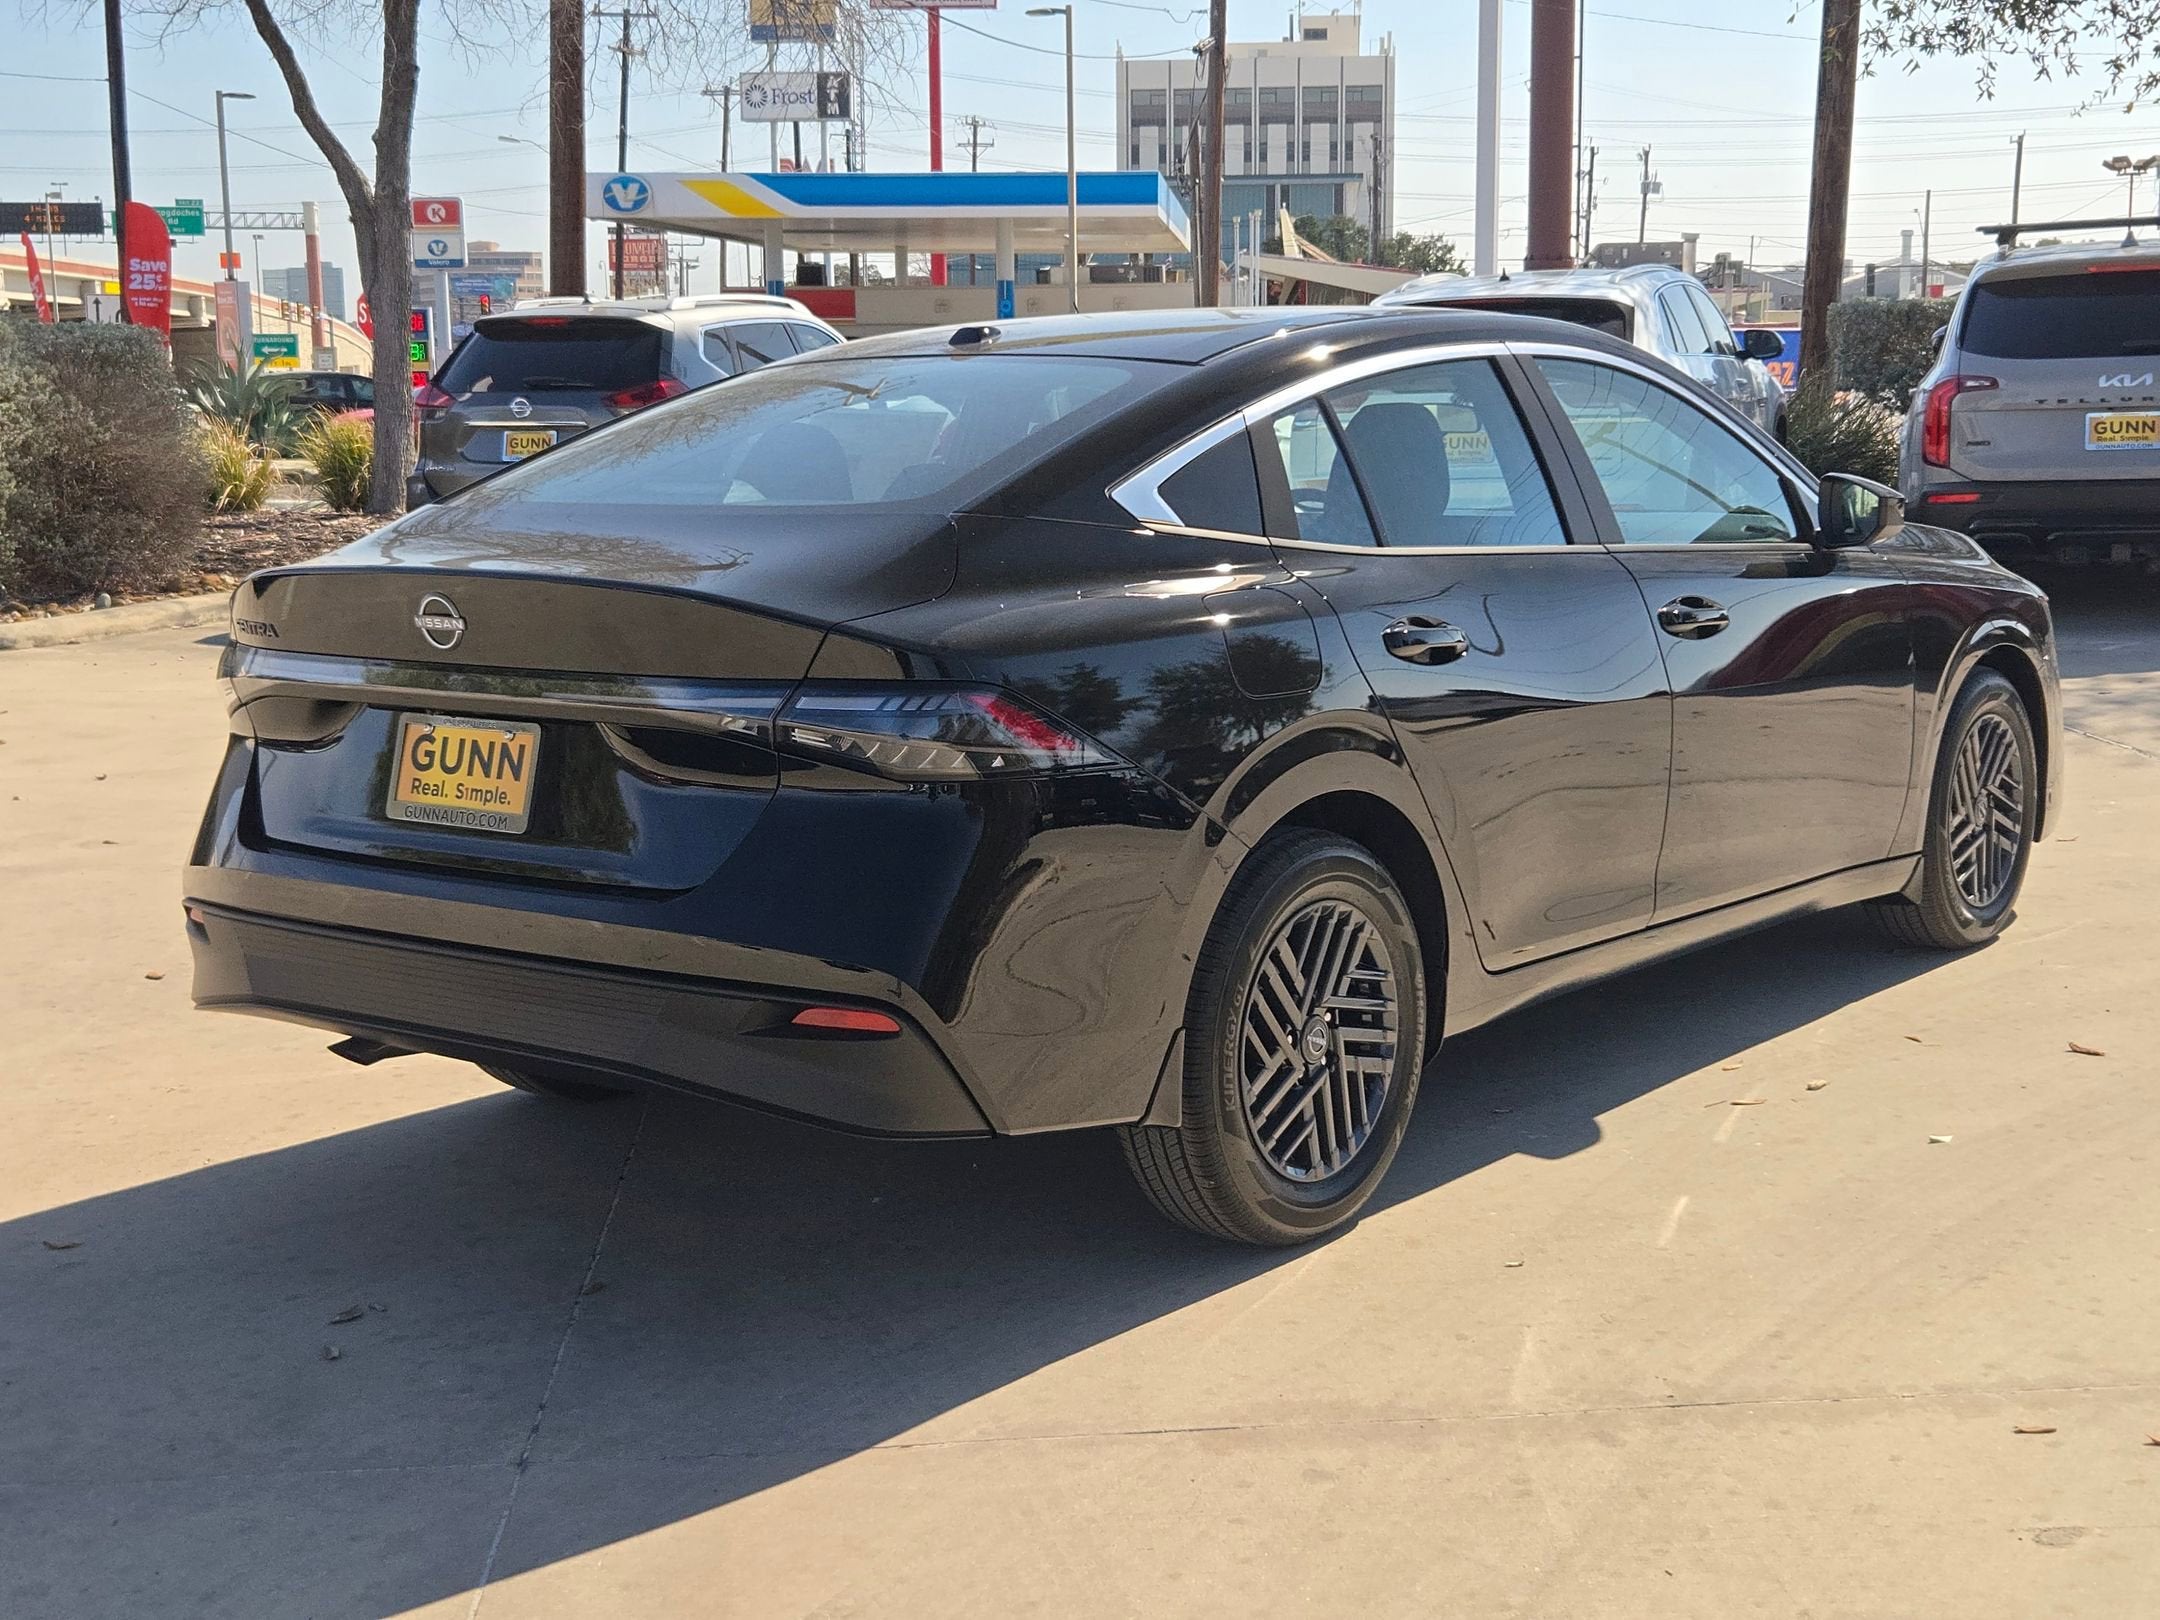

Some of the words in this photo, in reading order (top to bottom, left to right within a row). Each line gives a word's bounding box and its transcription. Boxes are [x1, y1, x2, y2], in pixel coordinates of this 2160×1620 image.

[771, 87, 815, 105] Frost
[129, 258, 167, 272] Save
[2093, 420, 2156, 435] GUNN
[509, 437, 552, 450] GUNN
[414, 615, 465, 630] NISSAN
[411, 733, 526, 783] GUNN
[410, 777, 449, 798] Real.
[404, 805, 509, 829] GUNNAUTO.COM
